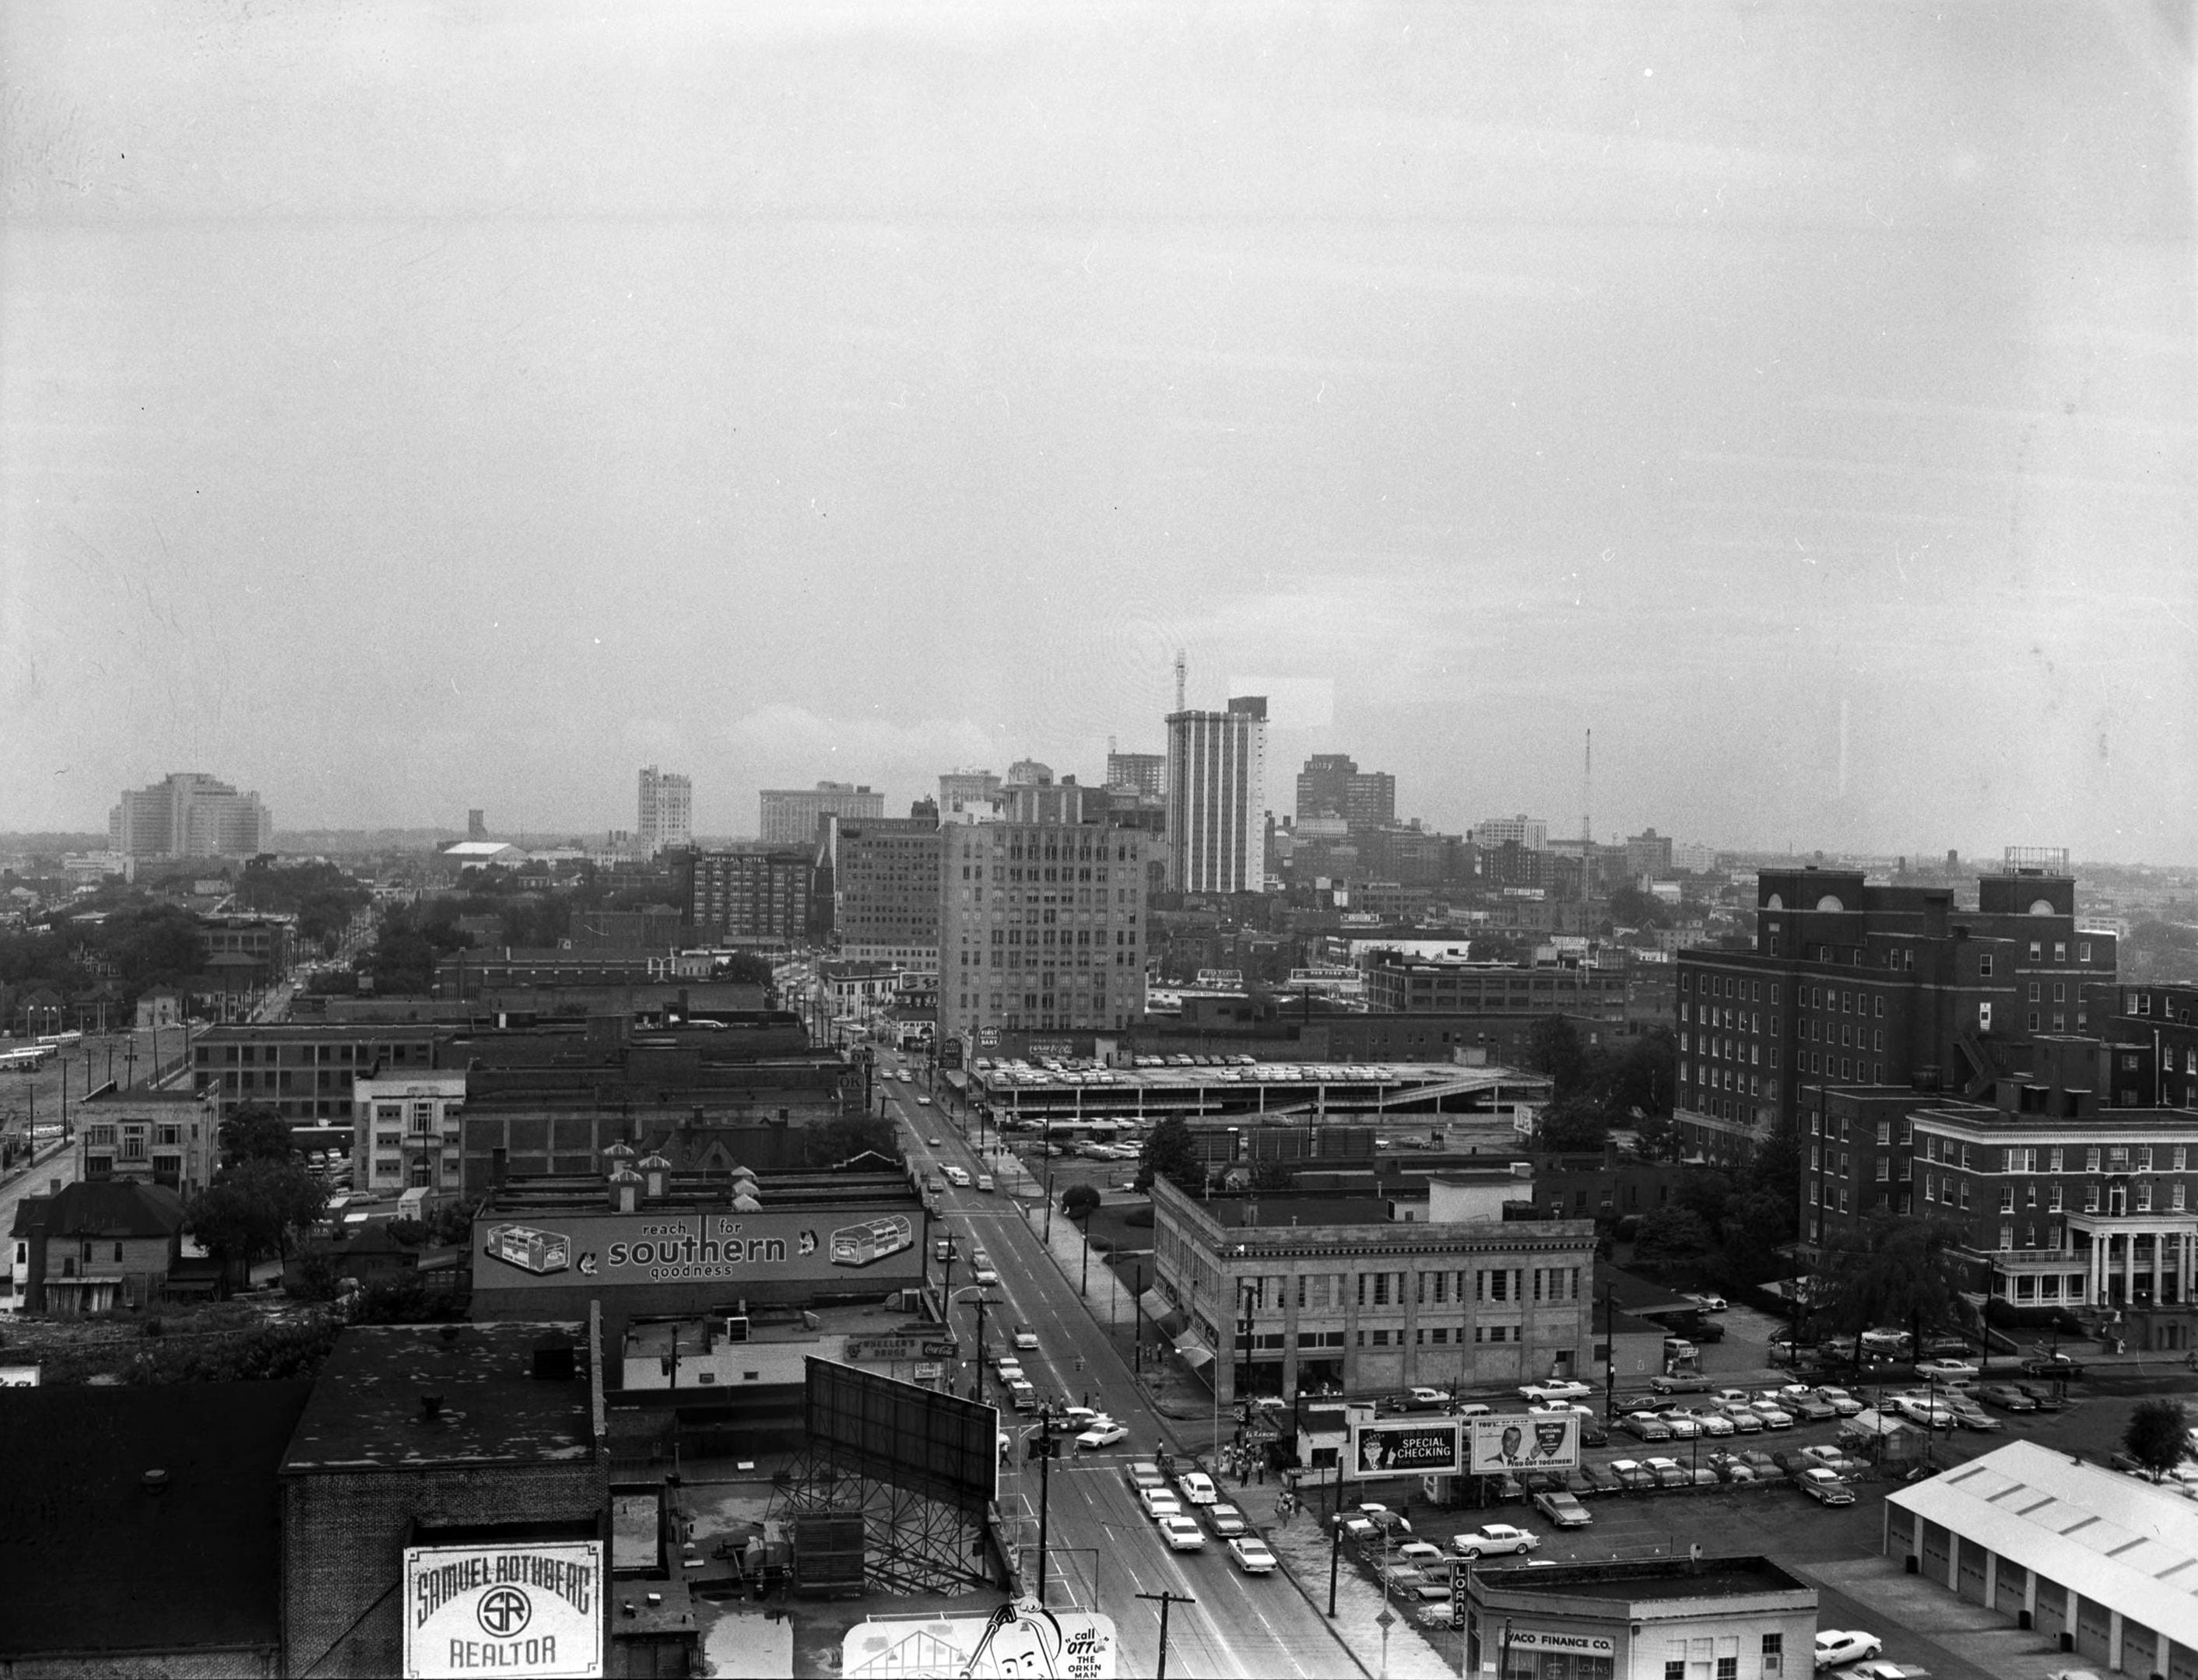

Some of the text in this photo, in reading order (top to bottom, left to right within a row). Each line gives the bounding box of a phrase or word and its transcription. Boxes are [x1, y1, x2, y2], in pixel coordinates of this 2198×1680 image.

[851, 1053, 870, 1062] OK
[839, 1076, 862, 1087] OK
[641, 1219, 743, 1236] reach for
[609, 1215, 786, 1266] southern
[649, 1262, 733, 1281] goodness
[863, 1339, 915, 1348] WHEELER'S
[874, 1349, 907, 1357] DRUGS
[1402, 1437, 1445, 1449] SPECIAL
[1397, 1447, 1451, 1459] CHECKING
[416, 1554, 591, 1630] SAMUEL ROTHBERG
[483, 1591, 525, 1632] SR
[1075, 1628, 1095, 1640] call
[1541, 1636, 1589, 1647] FINANCE
[1592, 1640, 1611, 1650] CO.
[449, 1635, 556, 1668] REALTOR
[1068, 1664, 1101, 1673] ORKIN
[1578, 1664, 1610, 1675] LOANS
